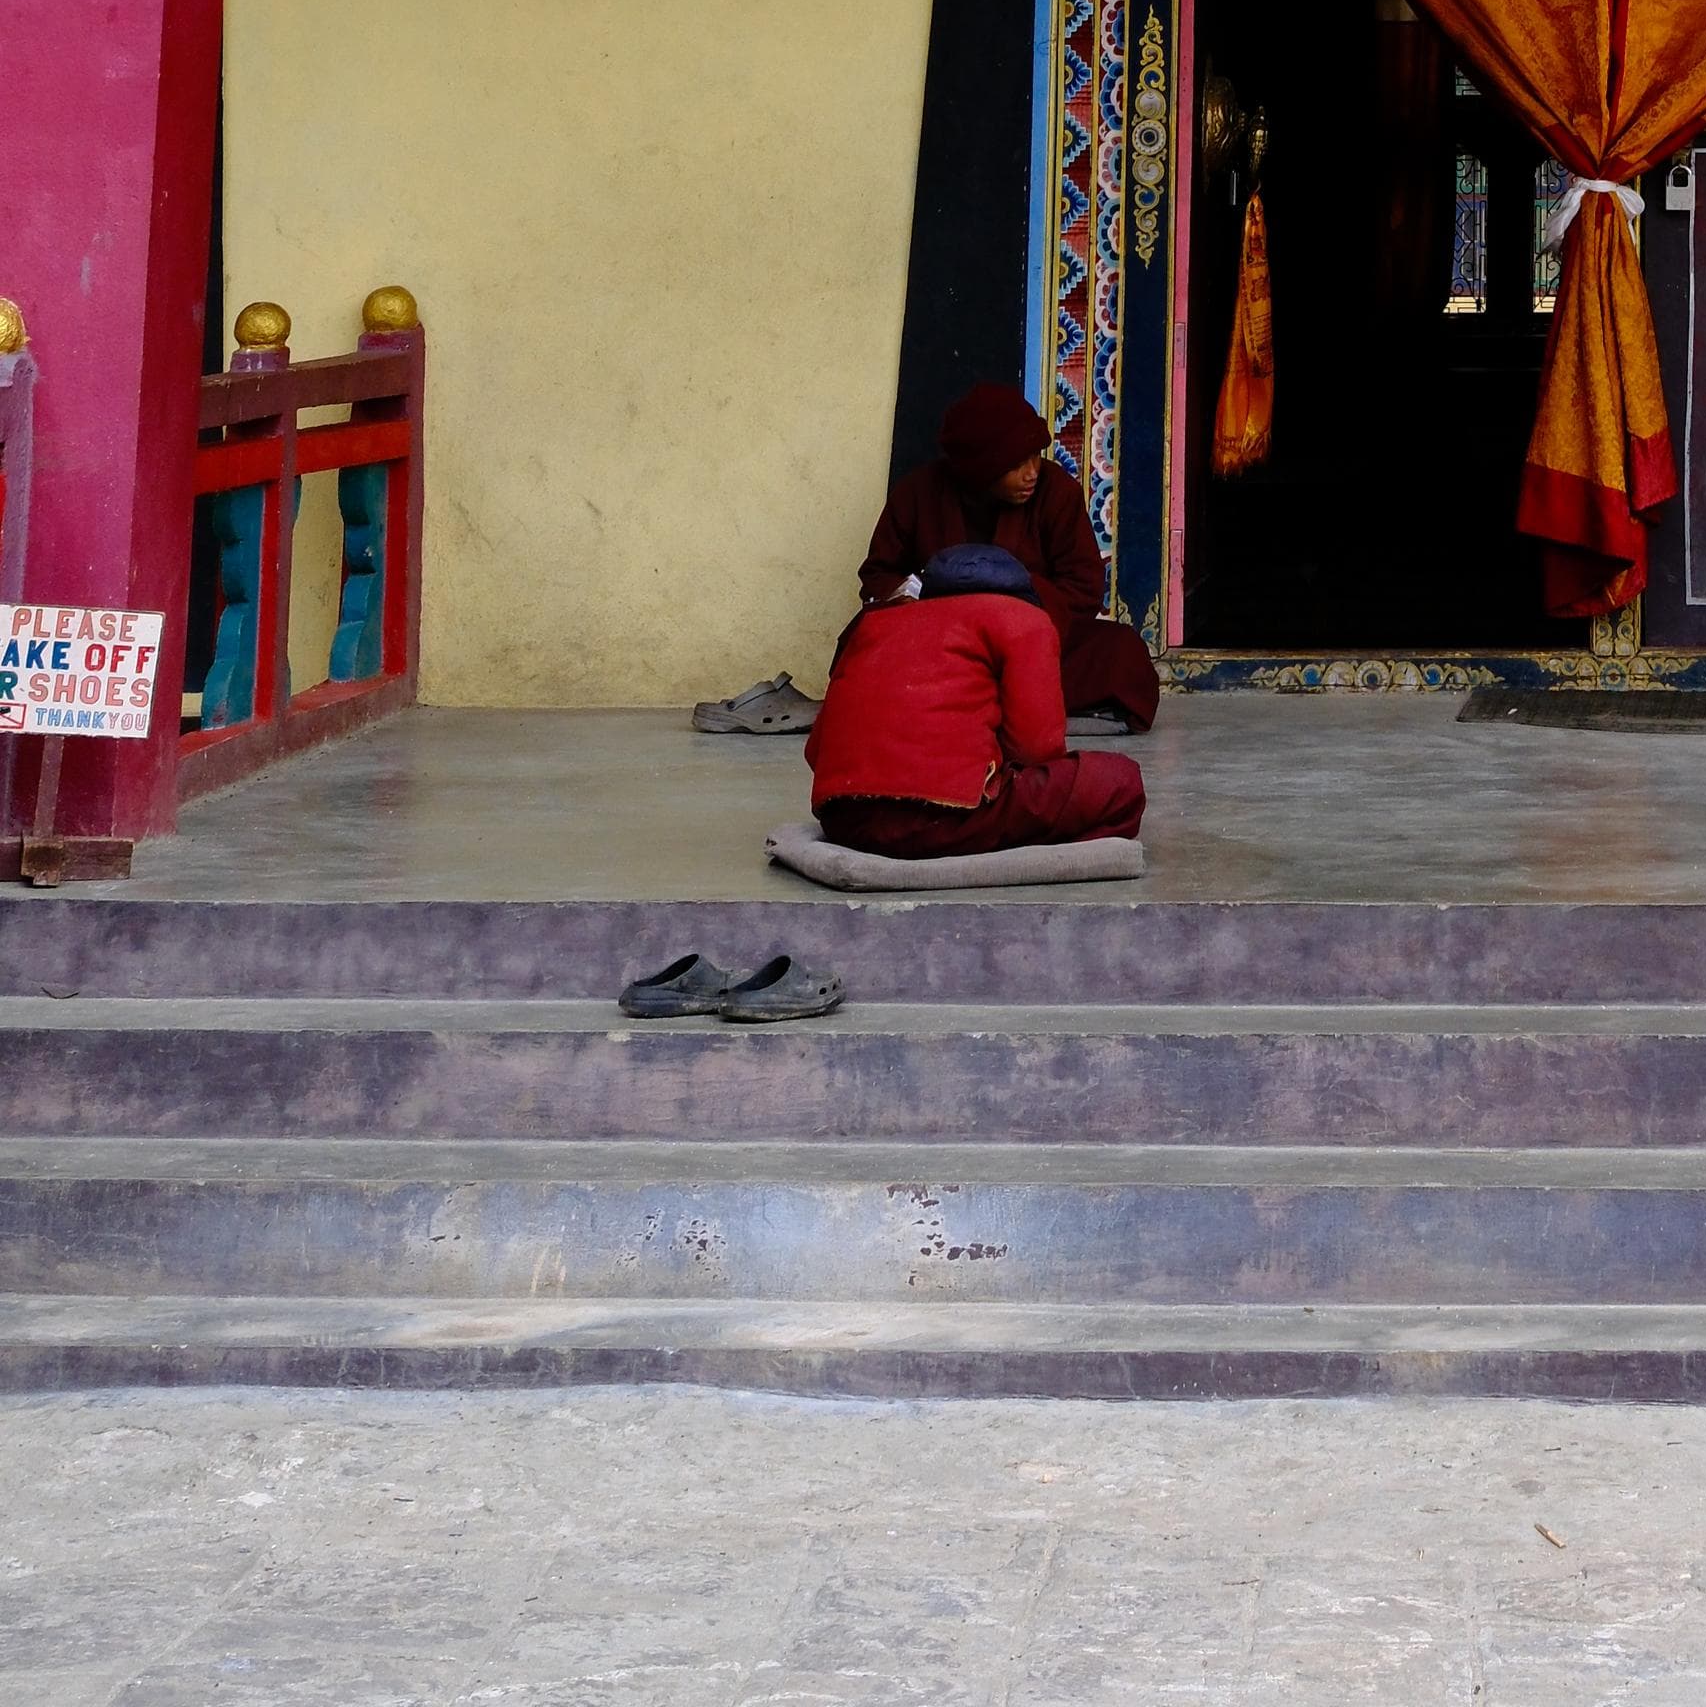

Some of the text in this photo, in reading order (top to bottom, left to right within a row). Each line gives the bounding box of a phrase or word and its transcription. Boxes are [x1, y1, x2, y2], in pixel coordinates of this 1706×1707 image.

[11, 607, 139, 642] PLEASE
[0, 638, 156, 674] AKE OFF
[28, 672, 152, 708] SHOES
[35, 707, 148, 731] THANK YOU
